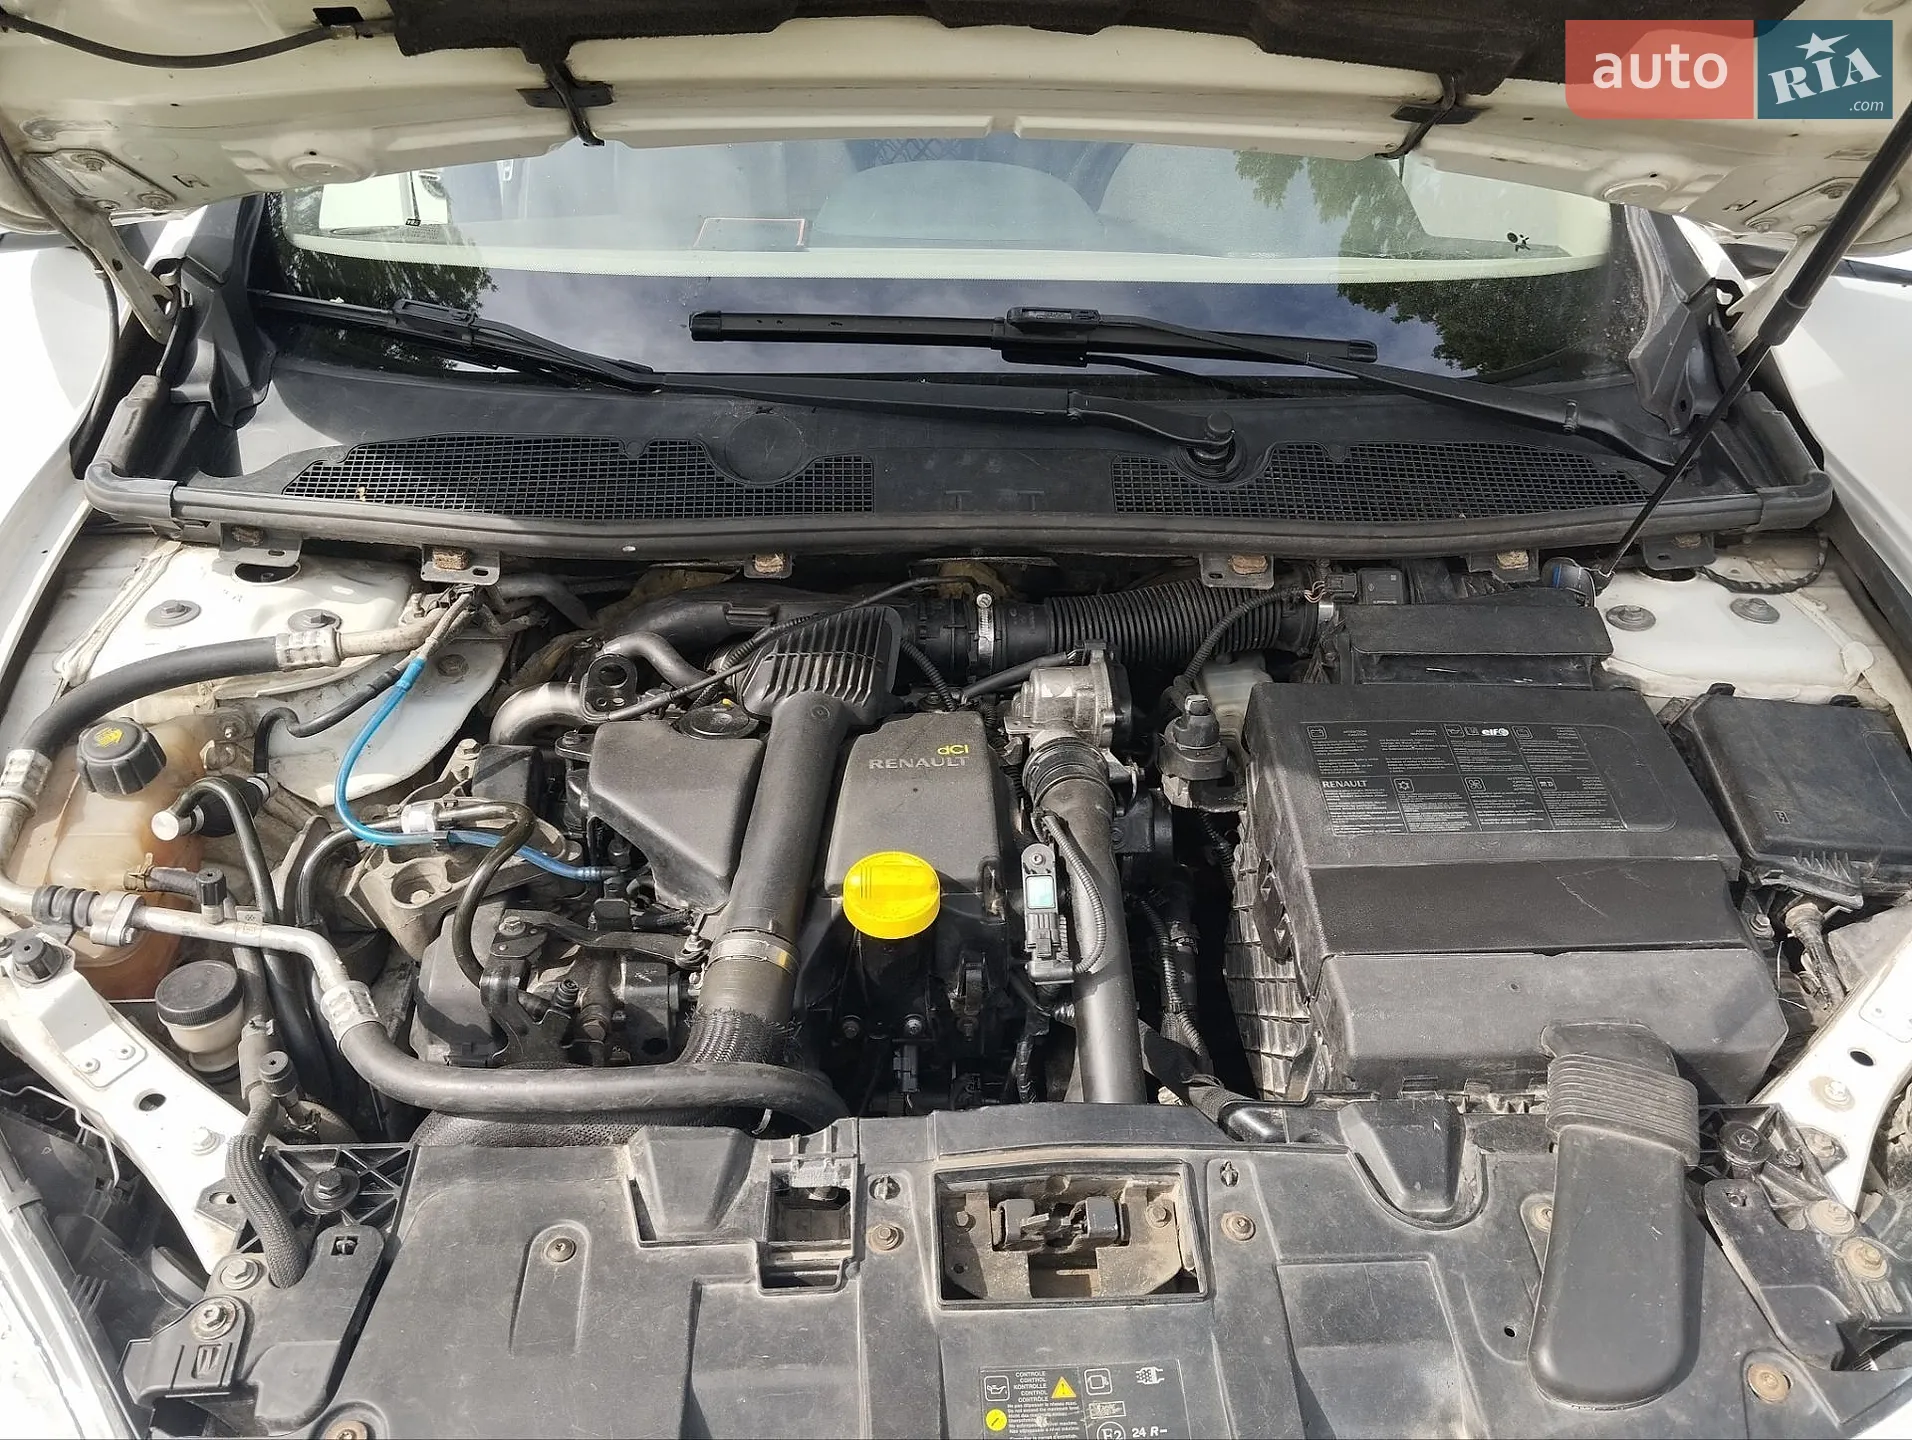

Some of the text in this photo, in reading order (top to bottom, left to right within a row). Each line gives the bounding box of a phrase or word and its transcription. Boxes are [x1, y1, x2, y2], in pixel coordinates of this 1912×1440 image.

[869, 757, 969, 769] RENAULT
[1322, 780, 1368, 788] RENAULT
[1131, 1427, 1147, 1438] 24
